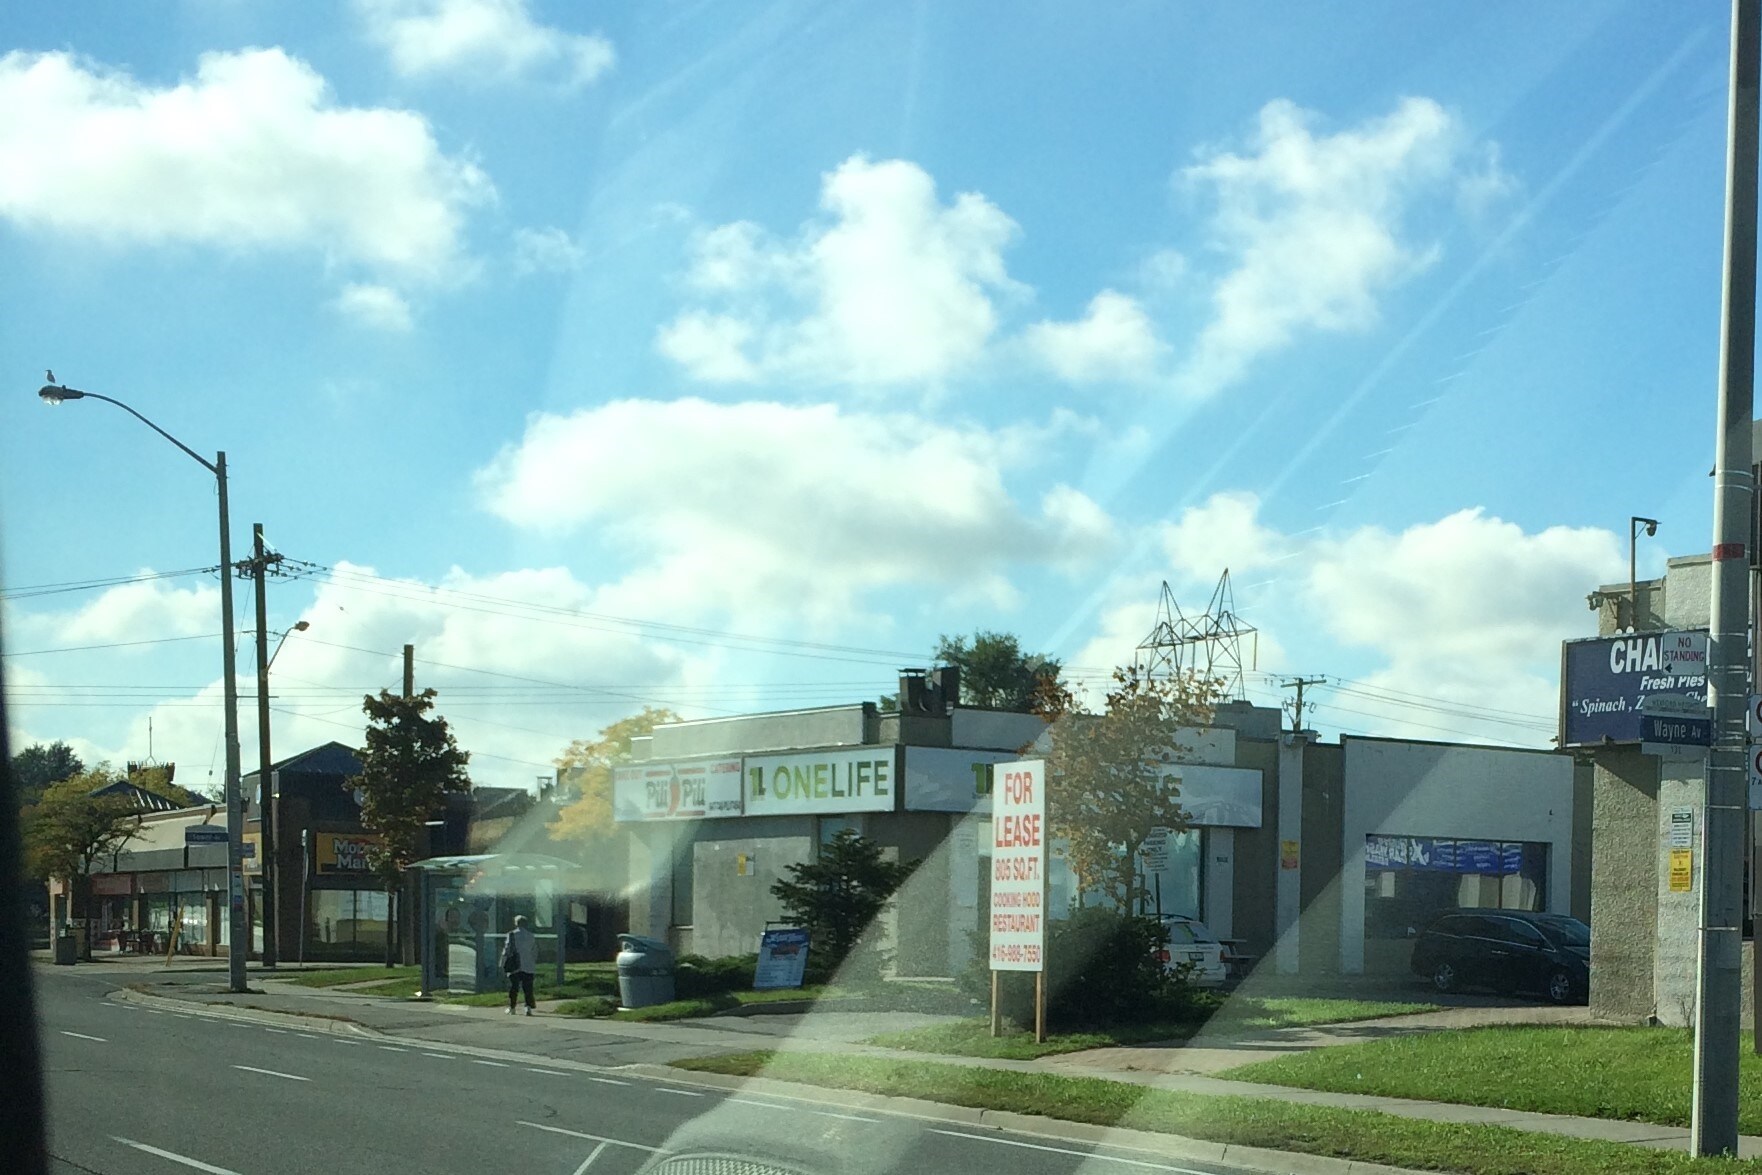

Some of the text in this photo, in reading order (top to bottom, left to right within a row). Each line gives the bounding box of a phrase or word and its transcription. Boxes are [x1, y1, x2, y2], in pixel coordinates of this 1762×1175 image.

[1678, 637, 1692, 648] NO
[1664, 650, 1705, 662] STANDING
[1640, 675, 1675, 691] Fresh
[1653, 720, 1702, 741] Wayne Av
[773, 760, 889, 799] ONELIFE
[1005, 771, 1033, 805] FOR
[646, 778, 705, 808] Pili Pili
[995, 813, 1041, 848] LEASE
[336, 854, 367, 869] Mar
[993, 891, 1041, 908] COOKING HOOD
[993, 913, 1040, 933] RESTAURANT
